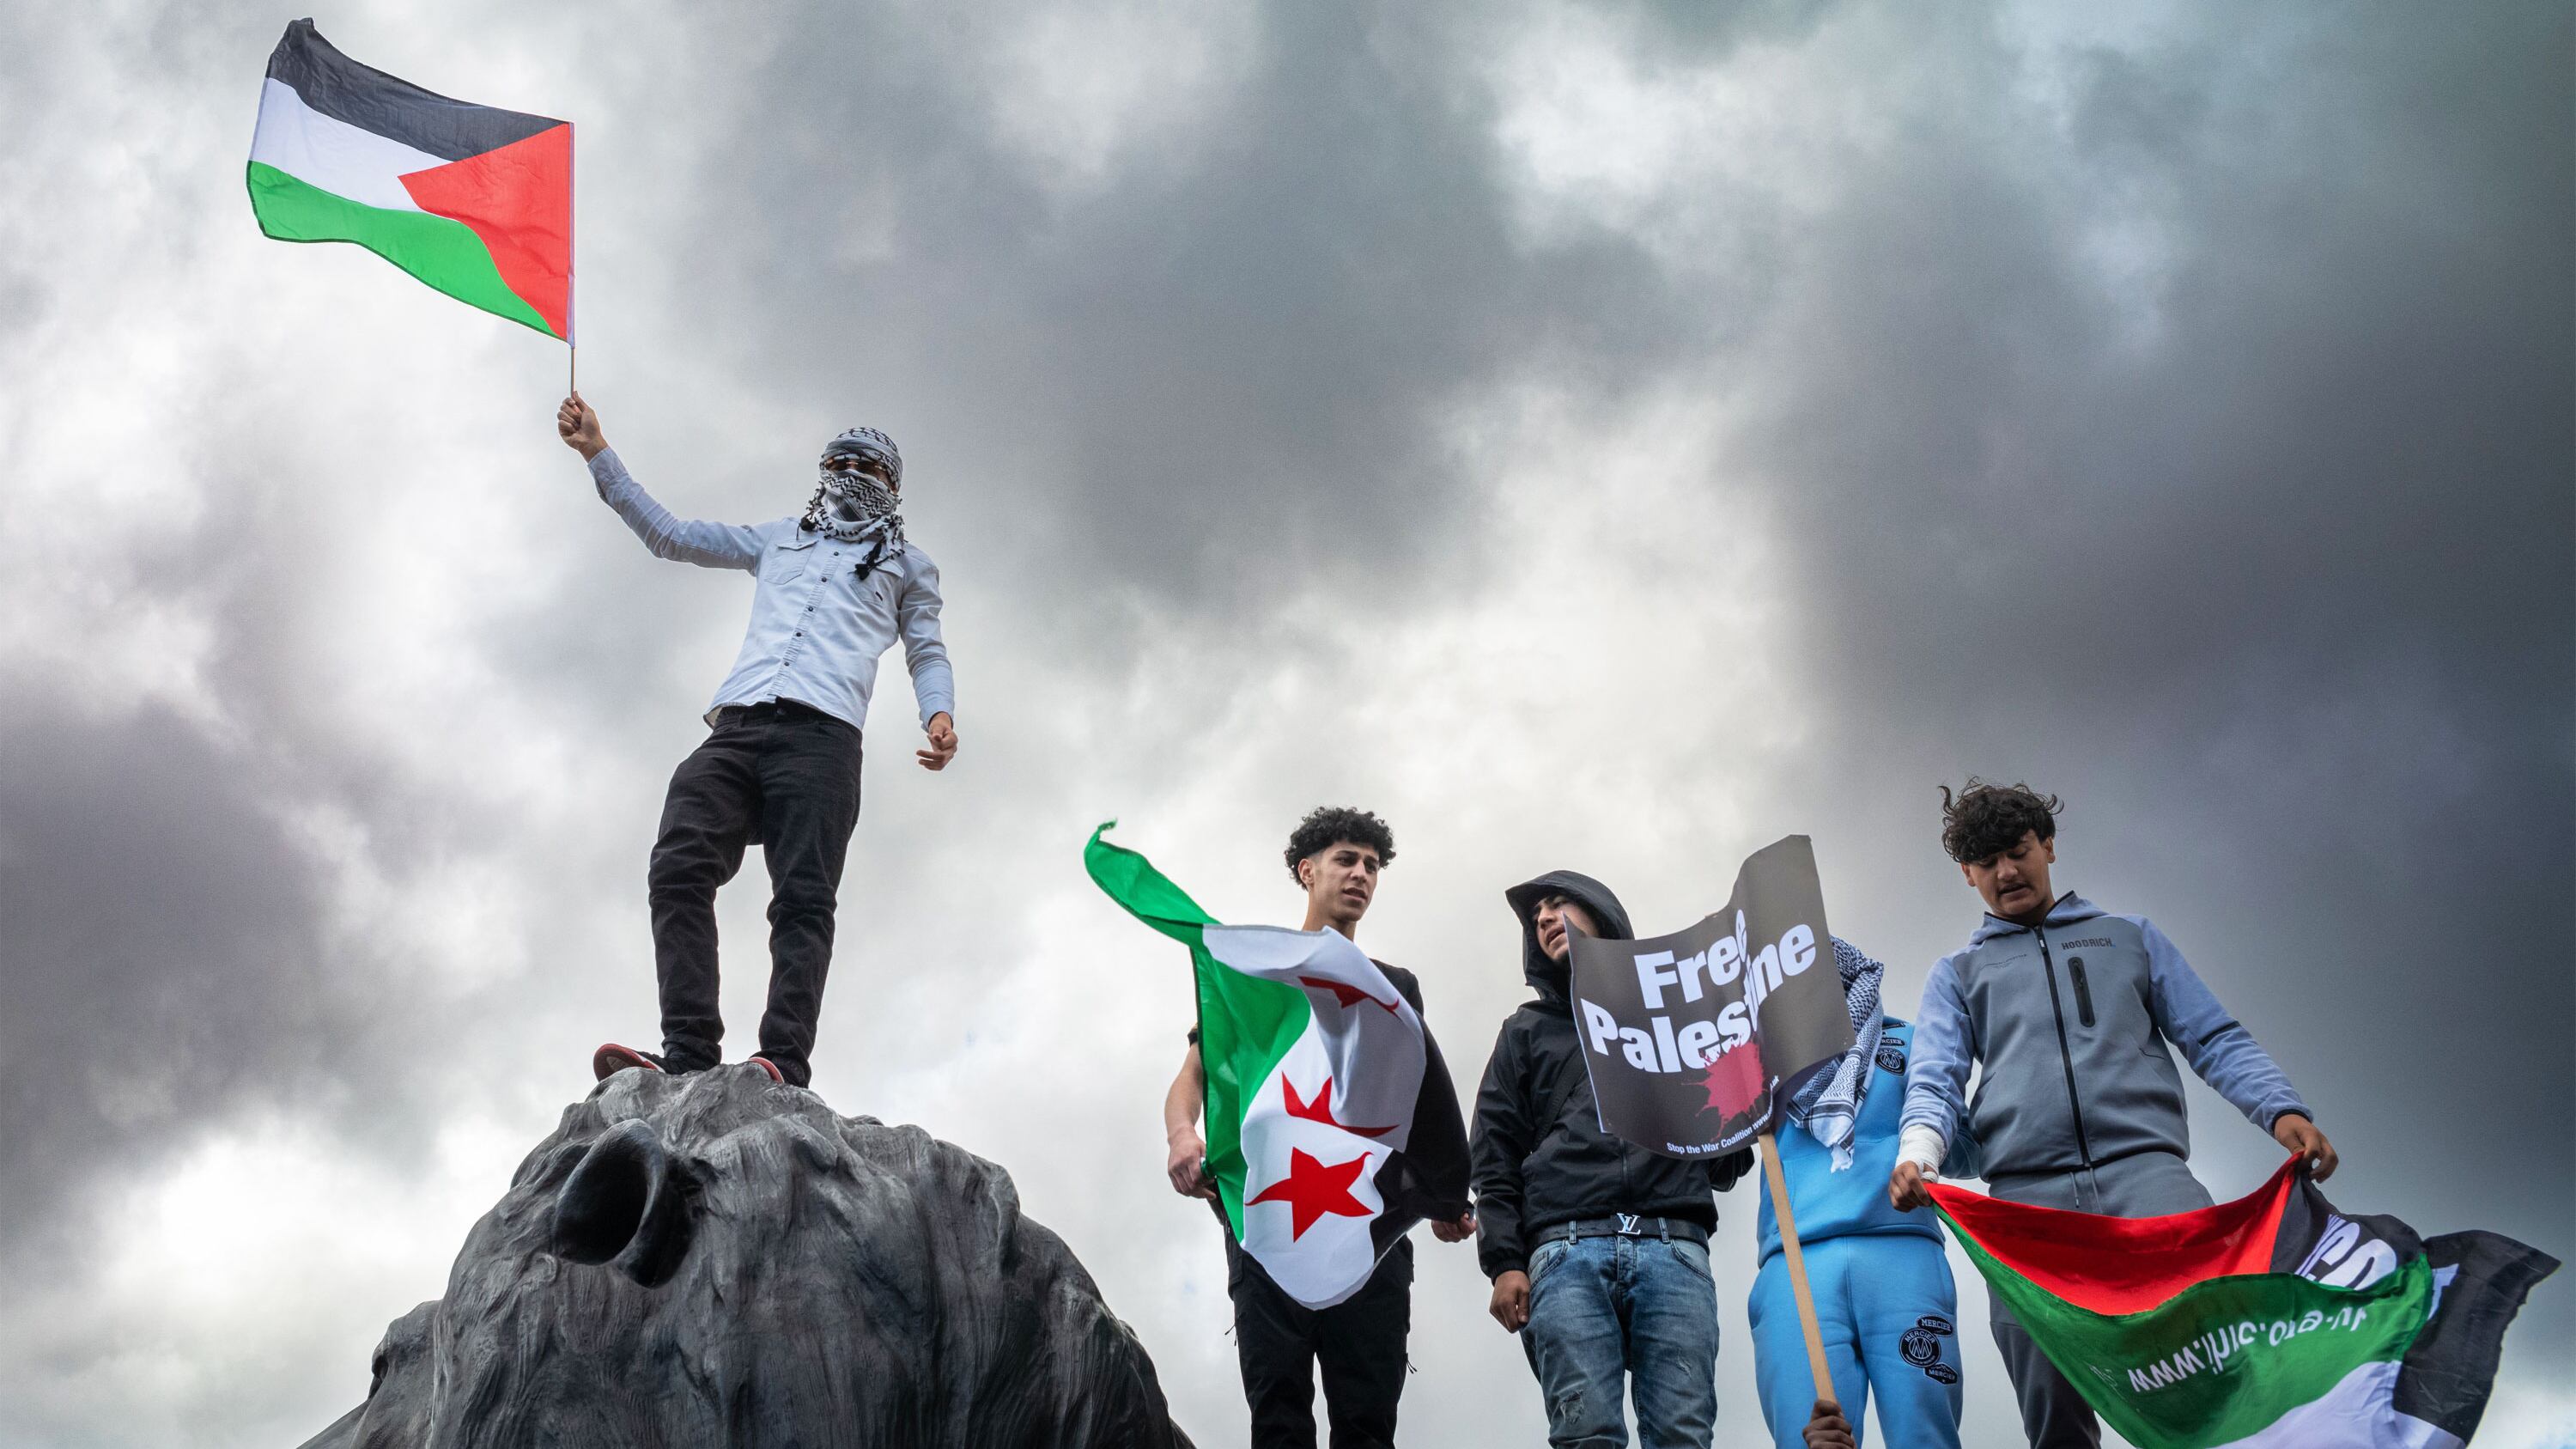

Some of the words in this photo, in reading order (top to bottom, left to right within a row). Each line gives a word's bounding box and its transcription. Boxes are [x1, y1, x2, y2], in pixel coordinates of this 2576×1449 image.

[1634, 910, 1747, 1009] Free
[1581, 924, 1816, 1073] Palestine
[1667, 1142, 1685, 1154] Stop
[1686, 1145, 1700, 1154] the
[1702, 1142, 1719, 1153] War
[1721, 1126, 1753, 1148] Coalition
[1921, 1318, 1952, 1332] MERCIER
[1905, 1330, 1935, 1343] MERCIER
[1929, 1369, 1955, 1380] MERCIER
